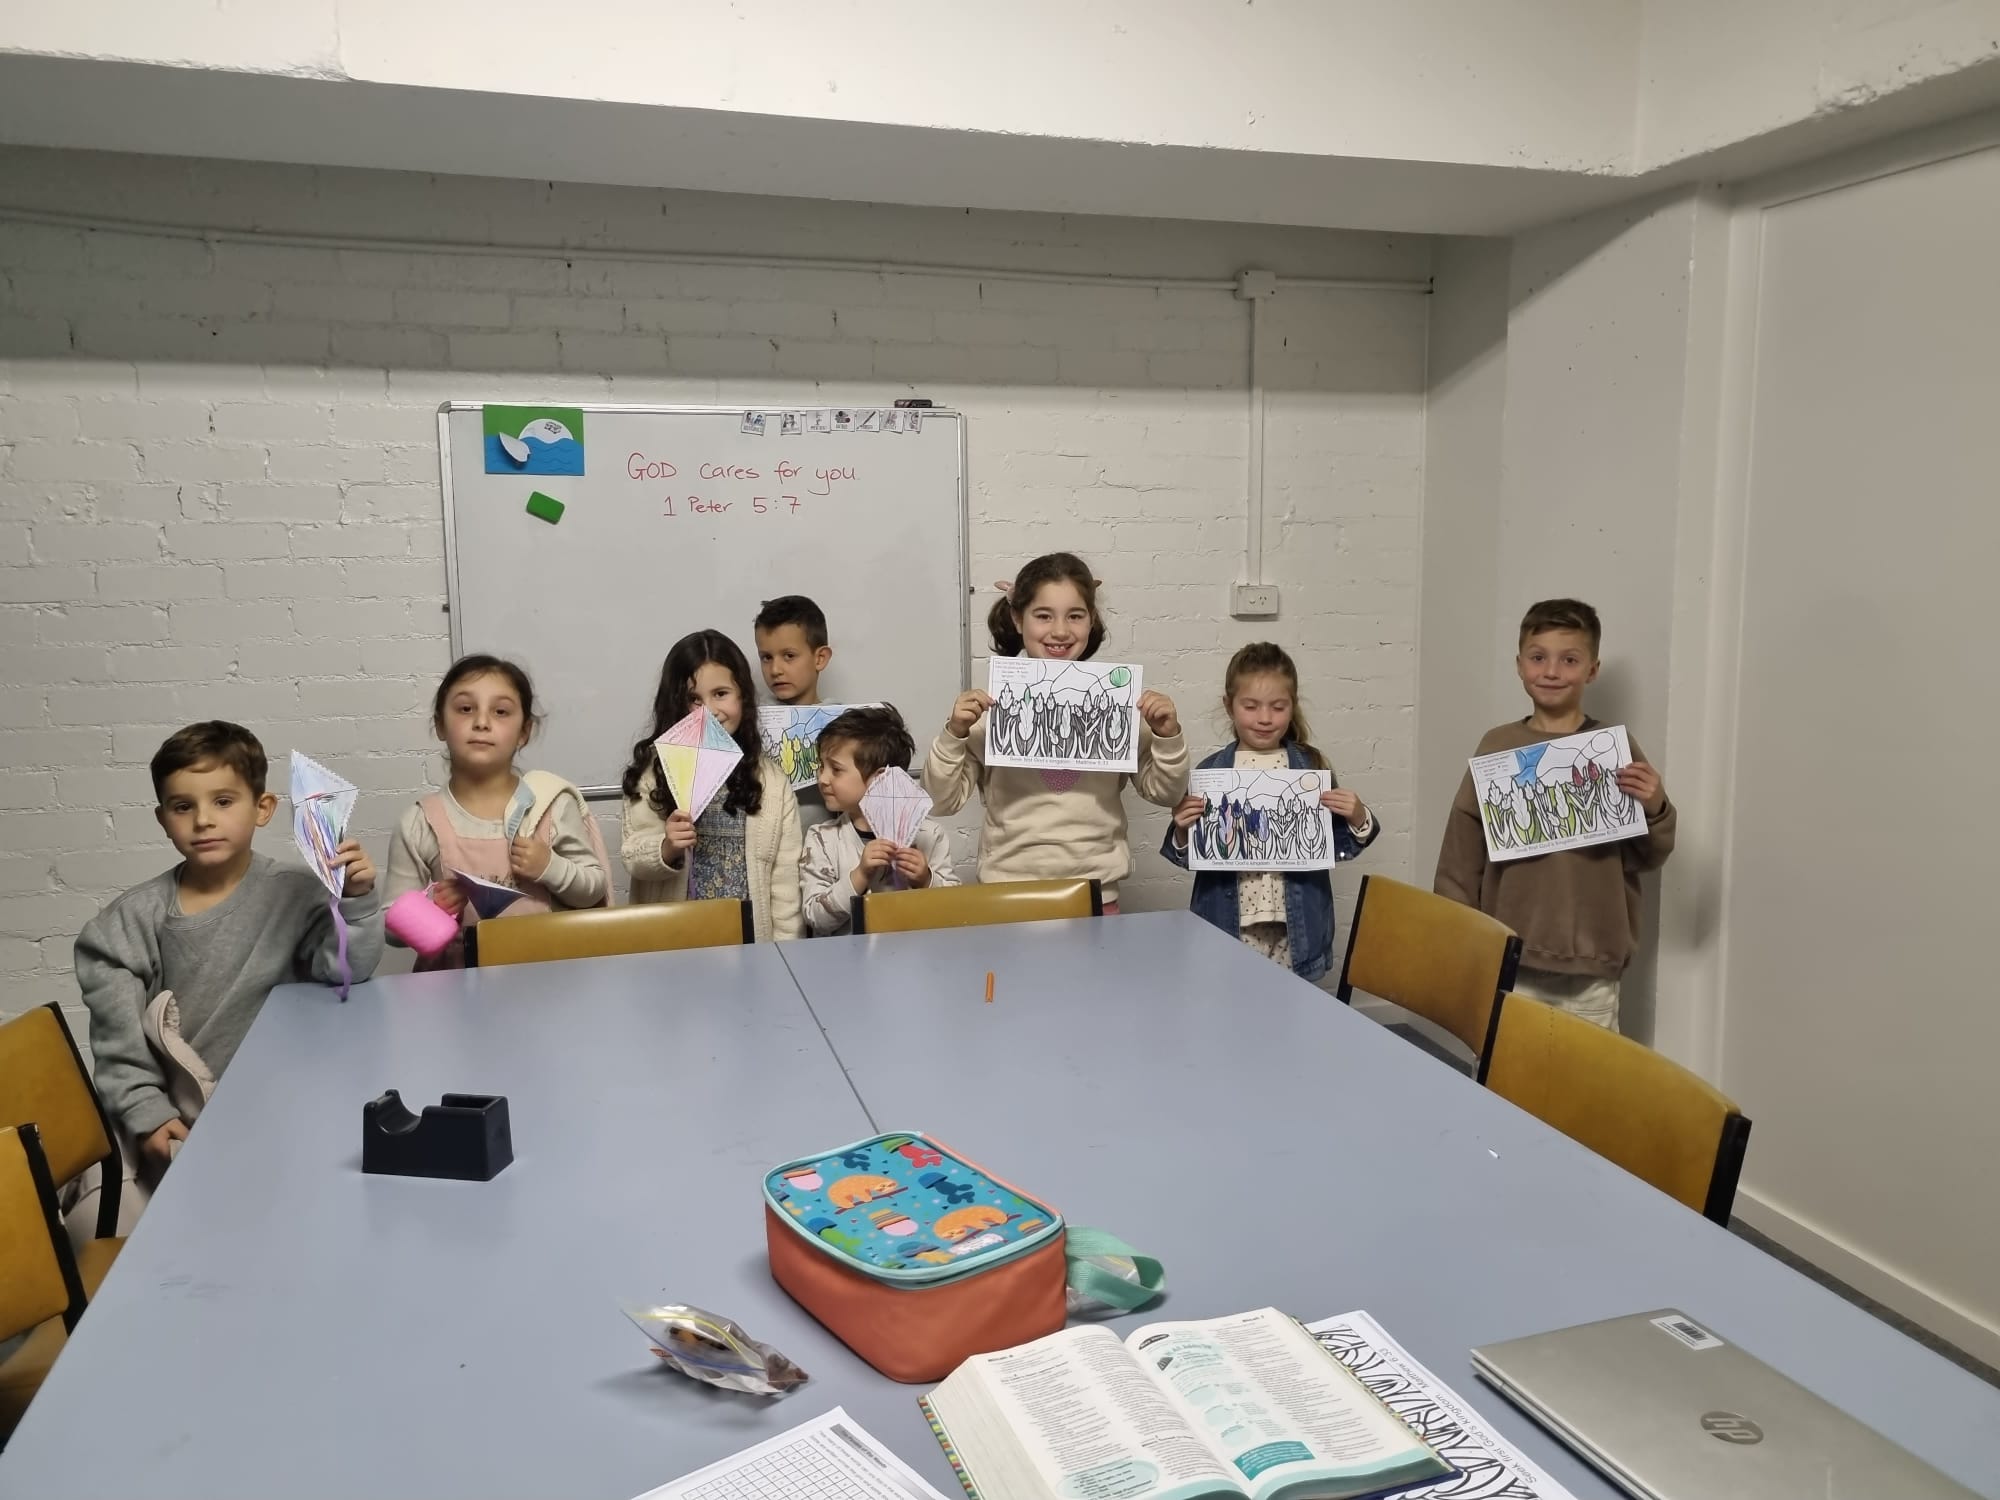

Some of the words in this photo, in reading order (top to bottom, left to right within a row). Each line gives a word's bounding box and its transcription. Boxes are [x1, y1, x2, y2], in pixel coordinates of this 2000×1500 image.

[627, 452, 678, 481] GOD
[699, 462, 761, 481] cares
[773, 460, 803, 485] for
[663, 496, 677, 517] 1
[687, 496, 734, 514] Peter
[752, 495, 802, 515] 5:7
[1399, 1363, 1430, 1389] Matthew
[1435, 1394, 1470, 1425] kingdom
[1468, 1425, 1495, 1447] God's
[1512, 1462, 1537, 1484] Seek
